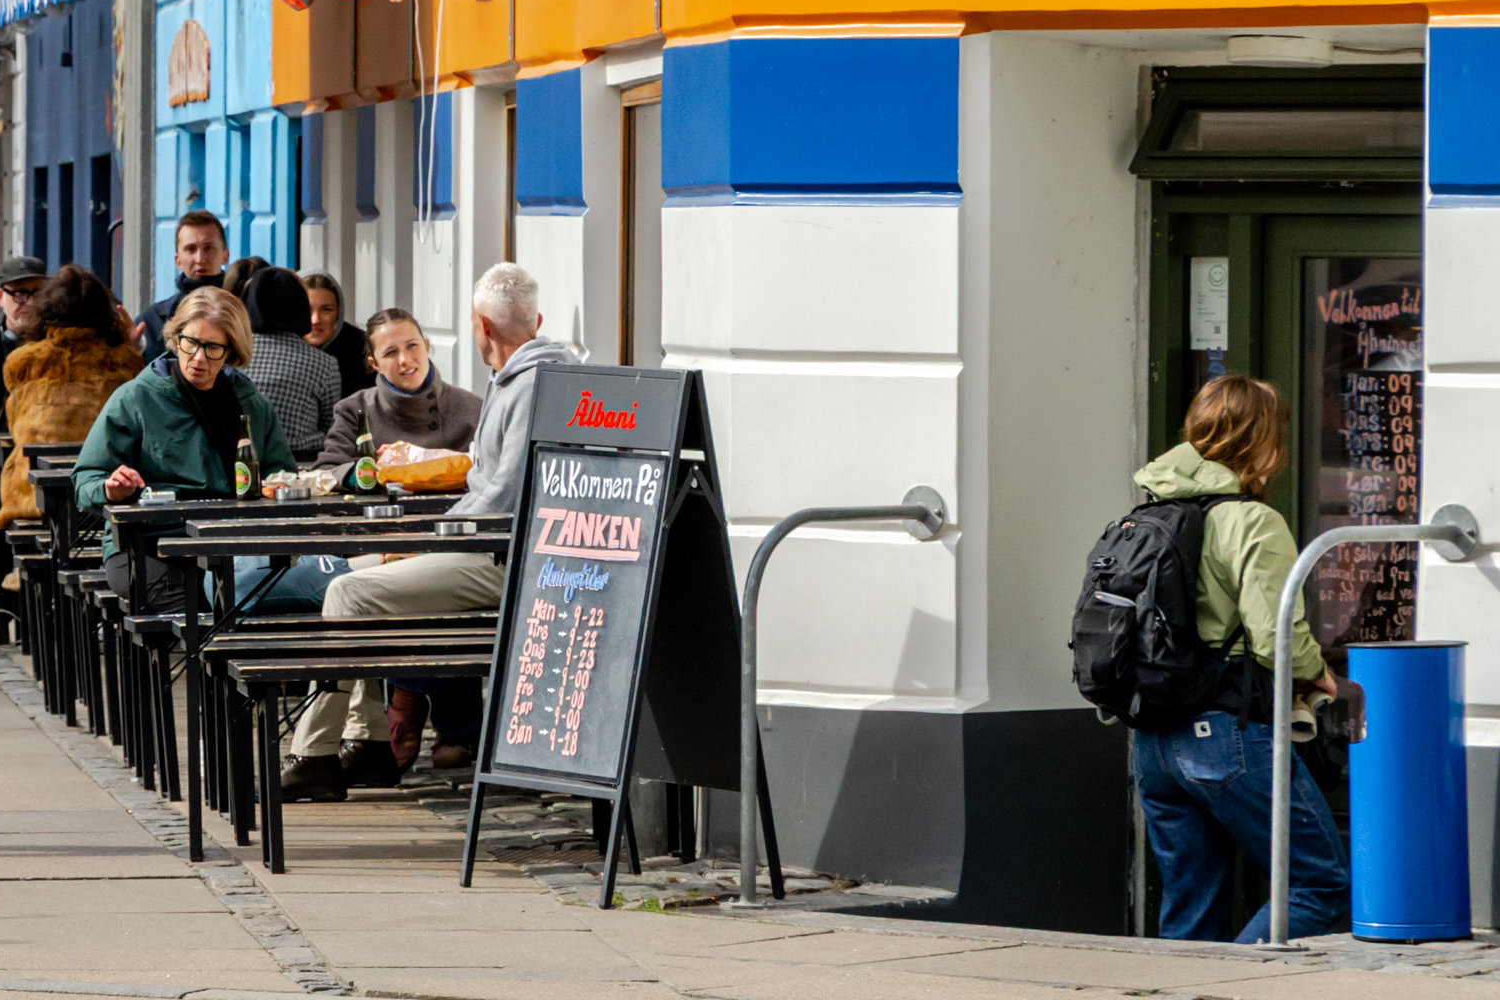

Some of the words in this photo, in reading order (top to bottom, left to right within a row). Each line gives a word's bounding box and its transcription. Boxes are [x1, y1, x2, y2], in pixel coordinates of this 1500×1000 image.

[566, 397, 638, 430] Albani
[534, 507, 641, 561] TANKEN
[532, 598, 556, 621] Man
[574, 605, 604, 628] 9-22
[526, 618, 548, 640] Tirs
[570, 627, 598, 647] 9-22
[523, 638, 545, 660] Ons
[566, 646, 594, 669] 9-23
[518, 656, 544, 678] Tors
[562, 667, 589, 690] 9-00
[516, 675, 534, 696] Fre
[559, 686, 585, 710] 9-00
[512, 694, 533, 715] Lør
[554, 706, 580, 731] 9-00
[506, 715, 533, 744] Søn
[550, 728, 578, 756] 9-18
